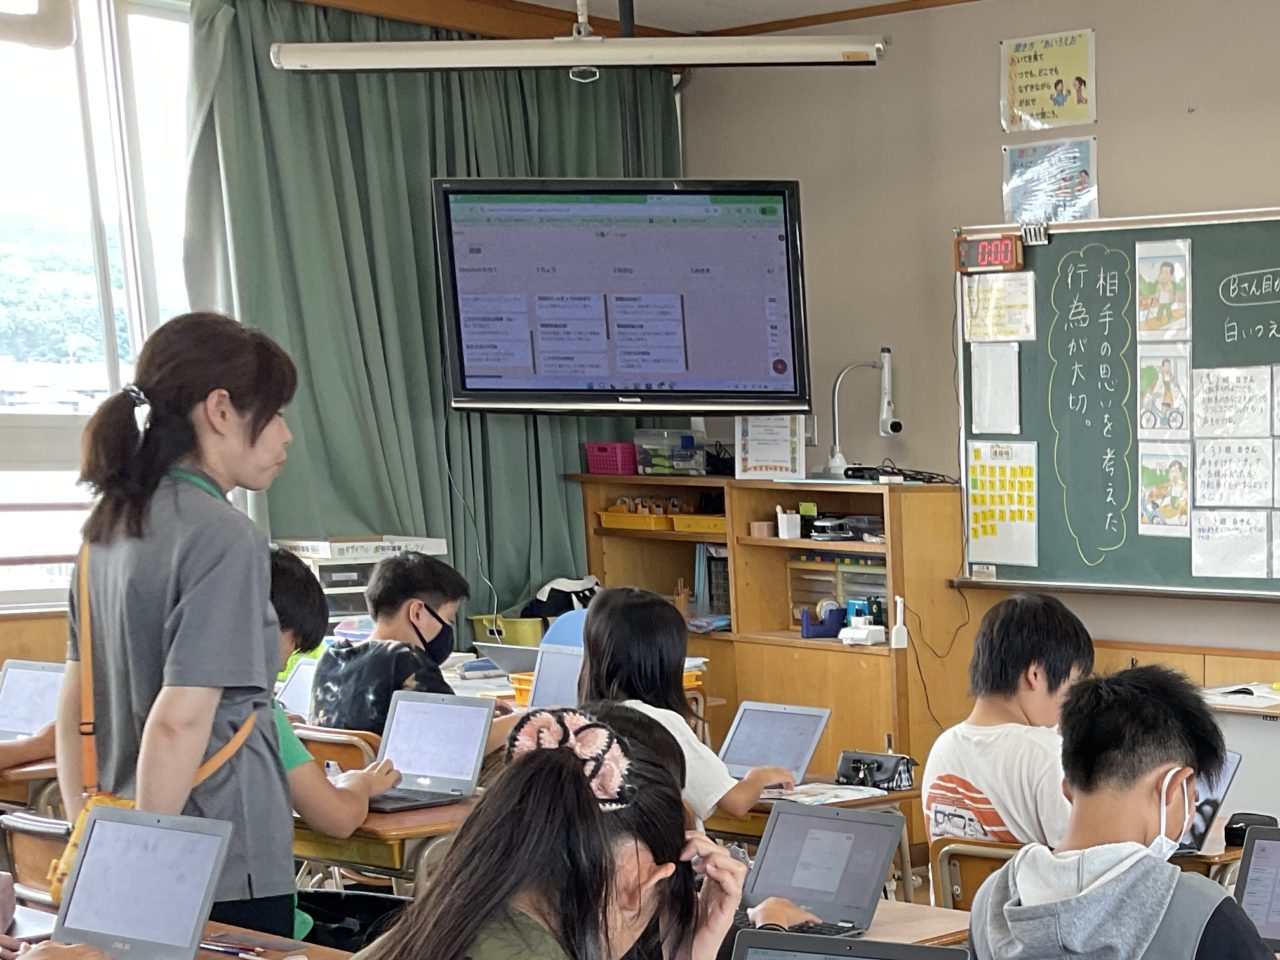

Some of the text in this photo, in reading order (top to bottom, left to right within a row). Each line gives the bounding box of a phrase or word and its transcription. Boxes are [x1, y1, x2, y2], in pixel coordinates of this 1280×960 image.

[1096, 267, 1120, 533] 相手の思いを考えた
